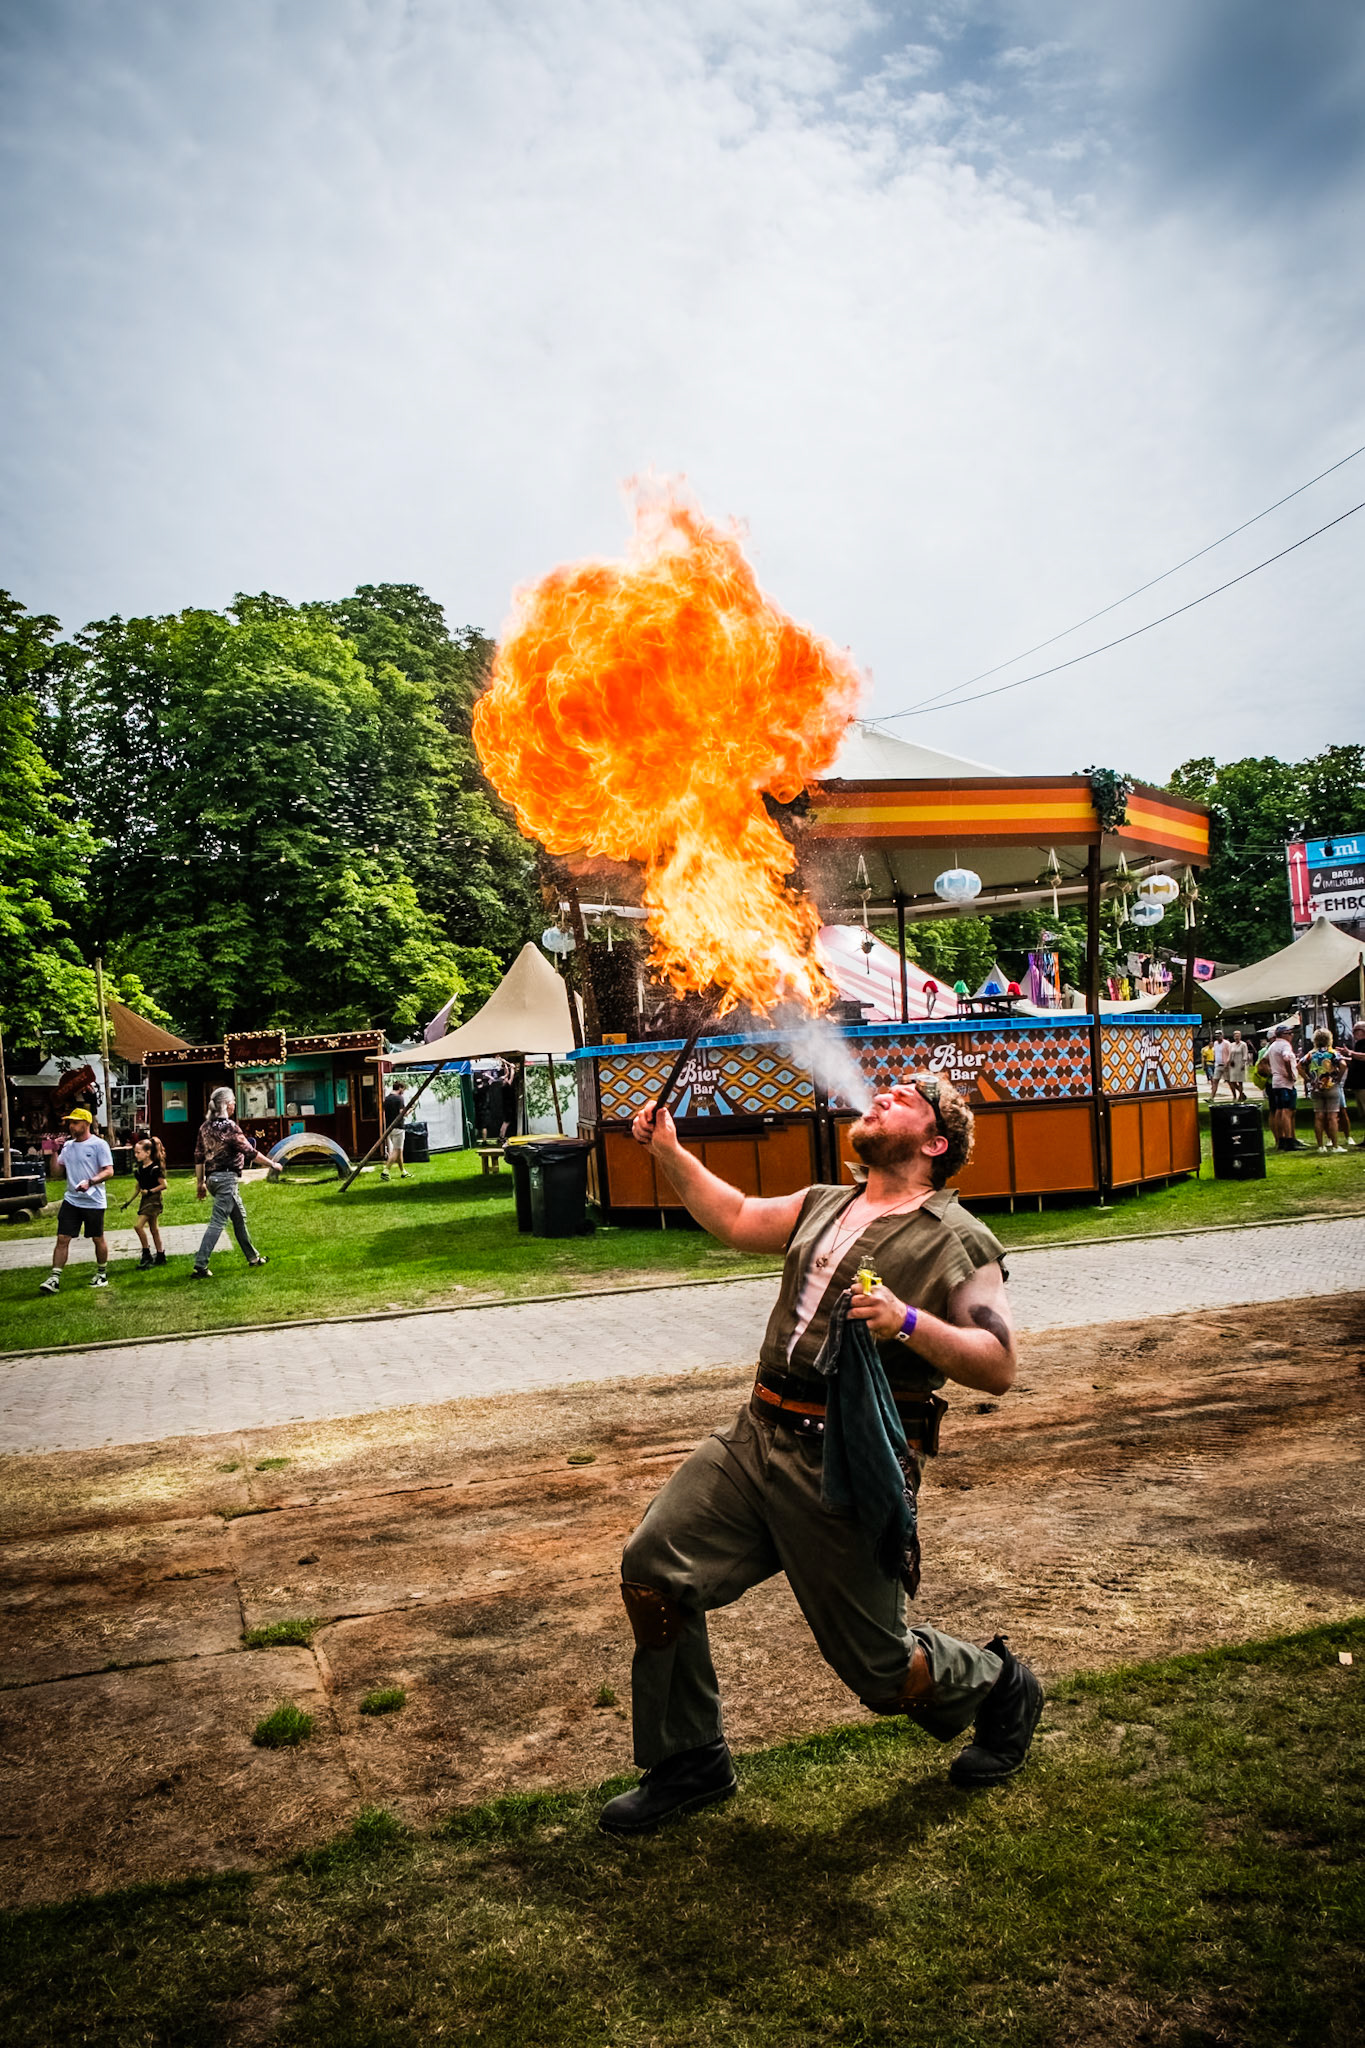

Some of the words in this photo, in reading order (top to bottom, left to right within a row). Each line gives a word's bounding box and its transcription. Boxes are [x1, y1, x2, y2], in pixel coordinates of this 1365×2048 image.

[1331, 869, 1354, 879] BABY
[1140, 1035, 1161, 1061] Bier
[929, 1042, 986, 1072] Bier
[1147, 1058, 1158, 1069] Bar
[675, 1058, 720, 1087] Bier
[950, 1069, 978, 1081] Bar
[693, 1084, 715, 1095] Bar
